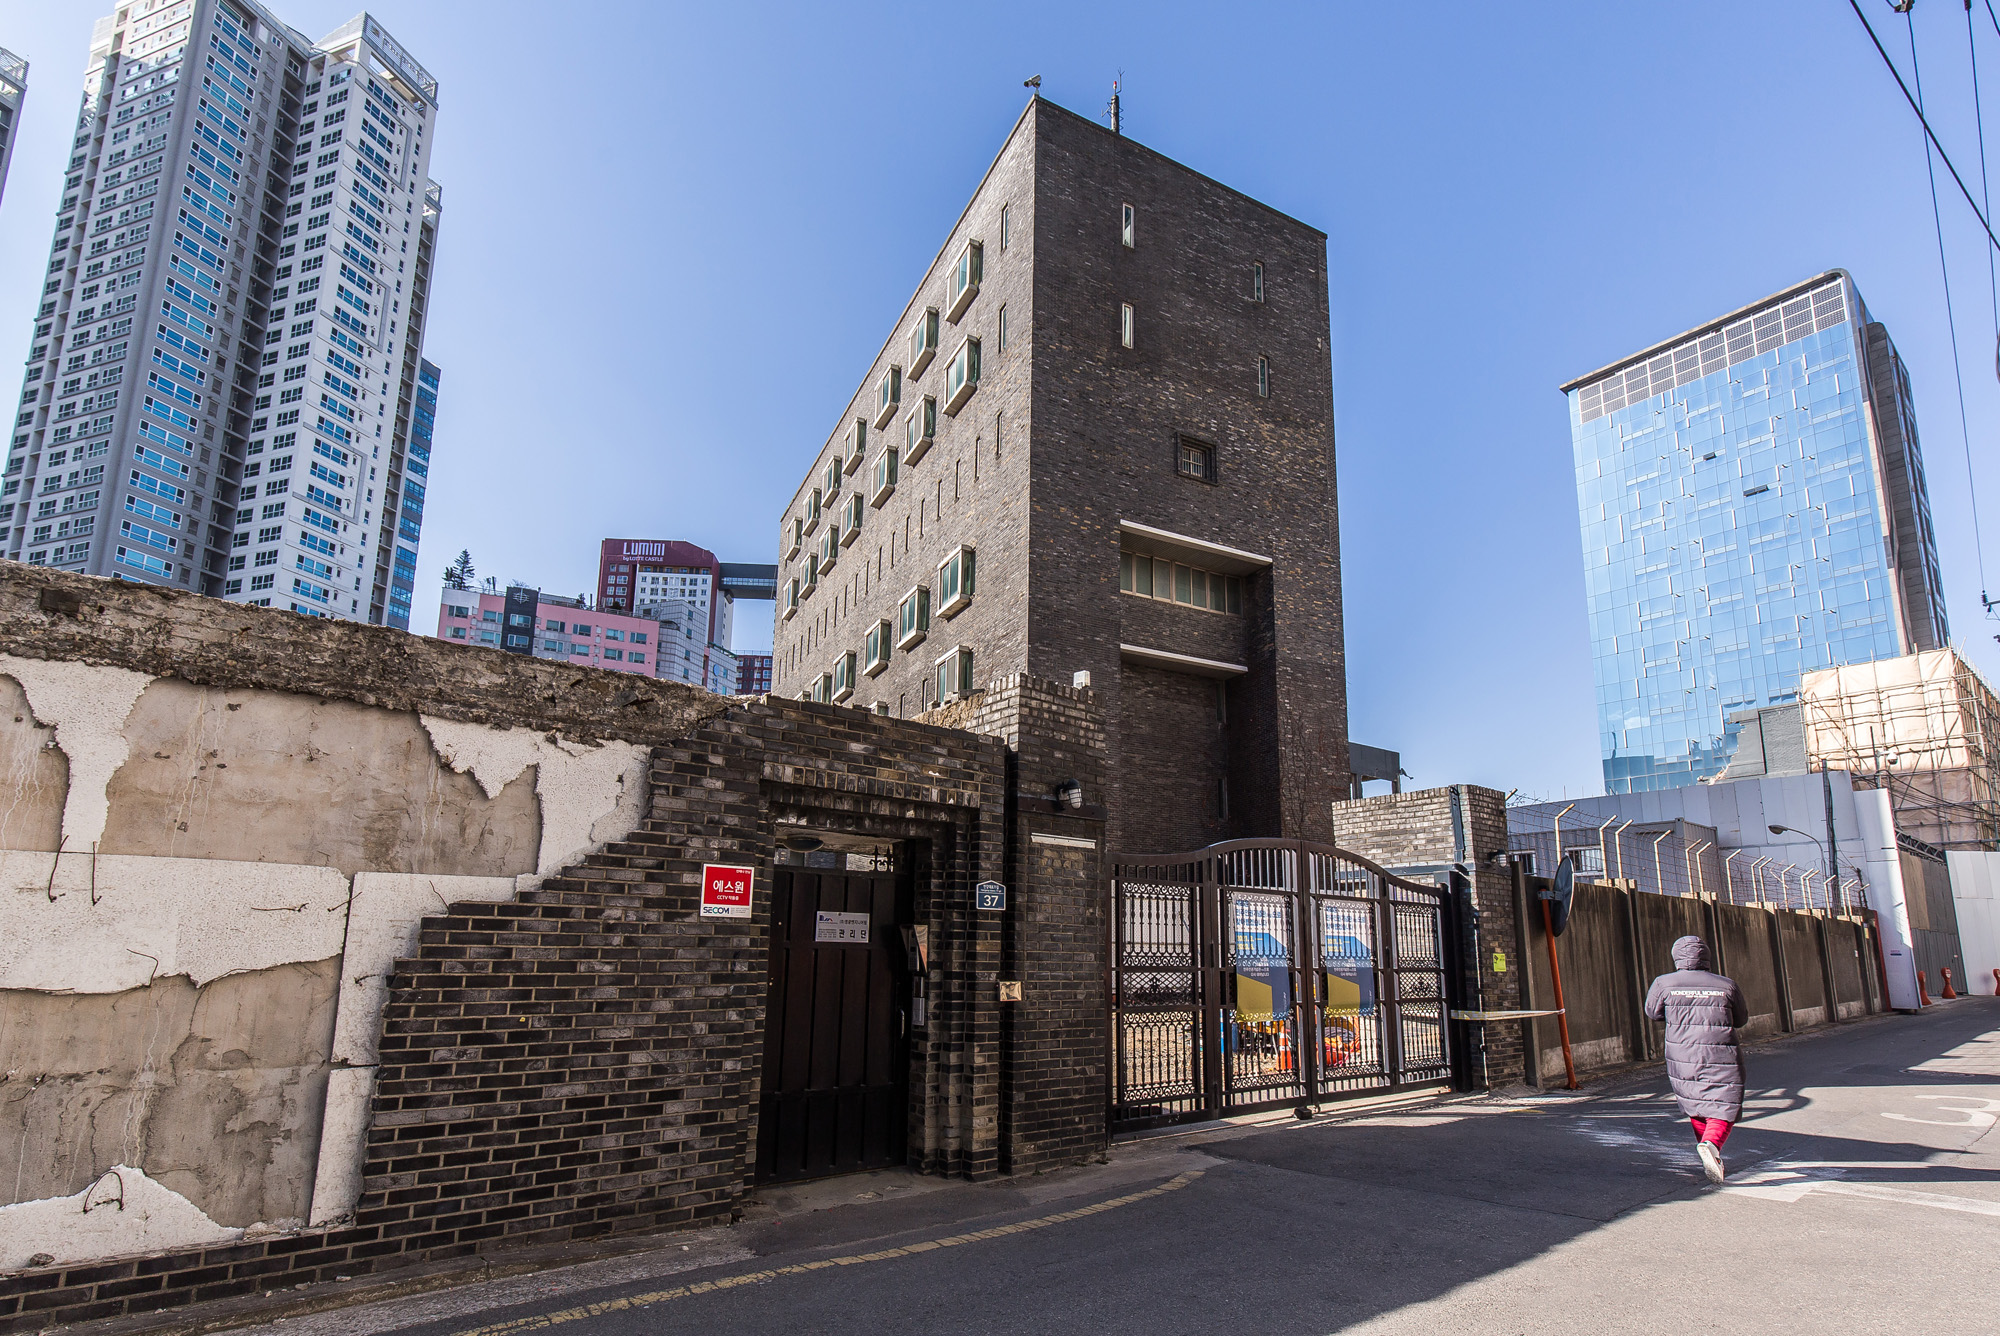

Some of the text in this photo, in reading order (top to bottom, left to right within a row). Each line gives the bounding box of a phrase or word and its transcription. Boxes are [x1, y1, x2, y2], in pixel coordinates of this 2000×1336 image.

[712, 880, 744, 894] 에스원
[983, 894, 999, 907] 37
[703, 906, 730, 915] SECOM
